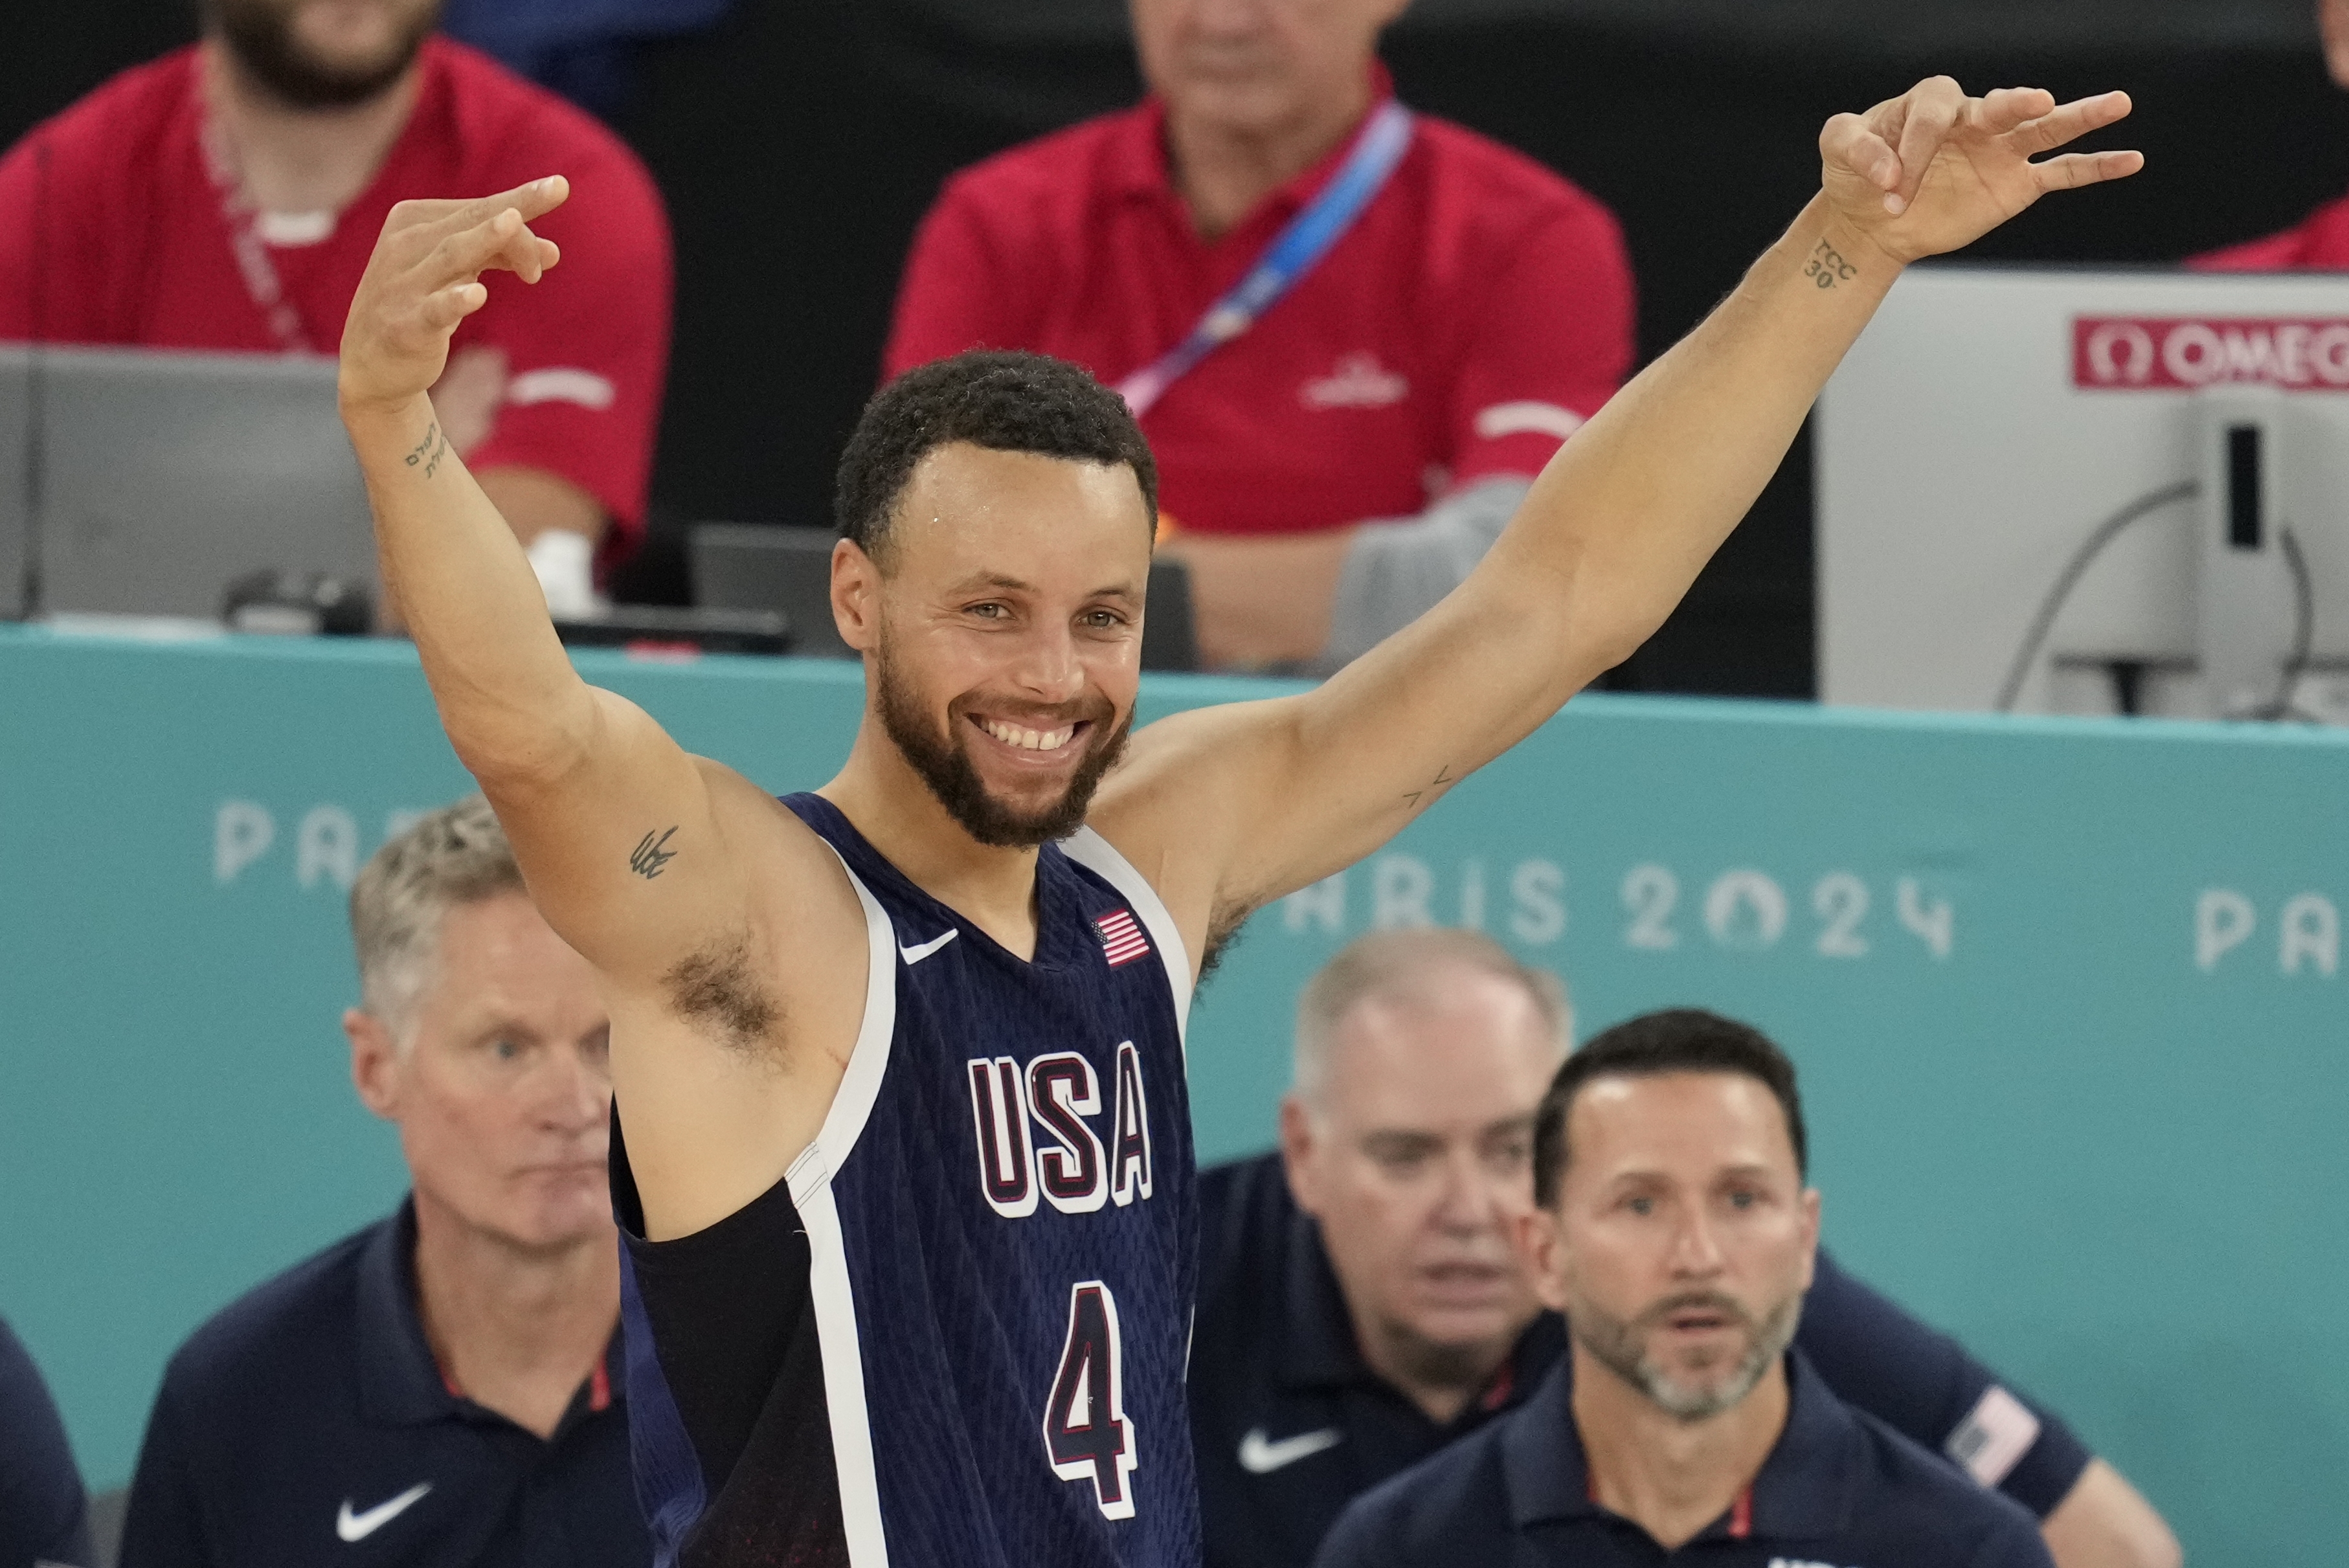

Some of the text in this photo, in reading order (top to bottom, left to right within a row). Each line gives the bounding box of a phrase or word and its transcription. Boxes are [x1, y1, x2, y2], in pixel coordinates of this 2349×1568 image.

[1815, 237, 1858, 280] TCC
[1284, 855, 1954, 957] ARIS 2024
[2196, 891, 2338, 974] PA
[968, 1040, 1152, 1218] USA
[1043, 1279, 1138, 1521] 4
